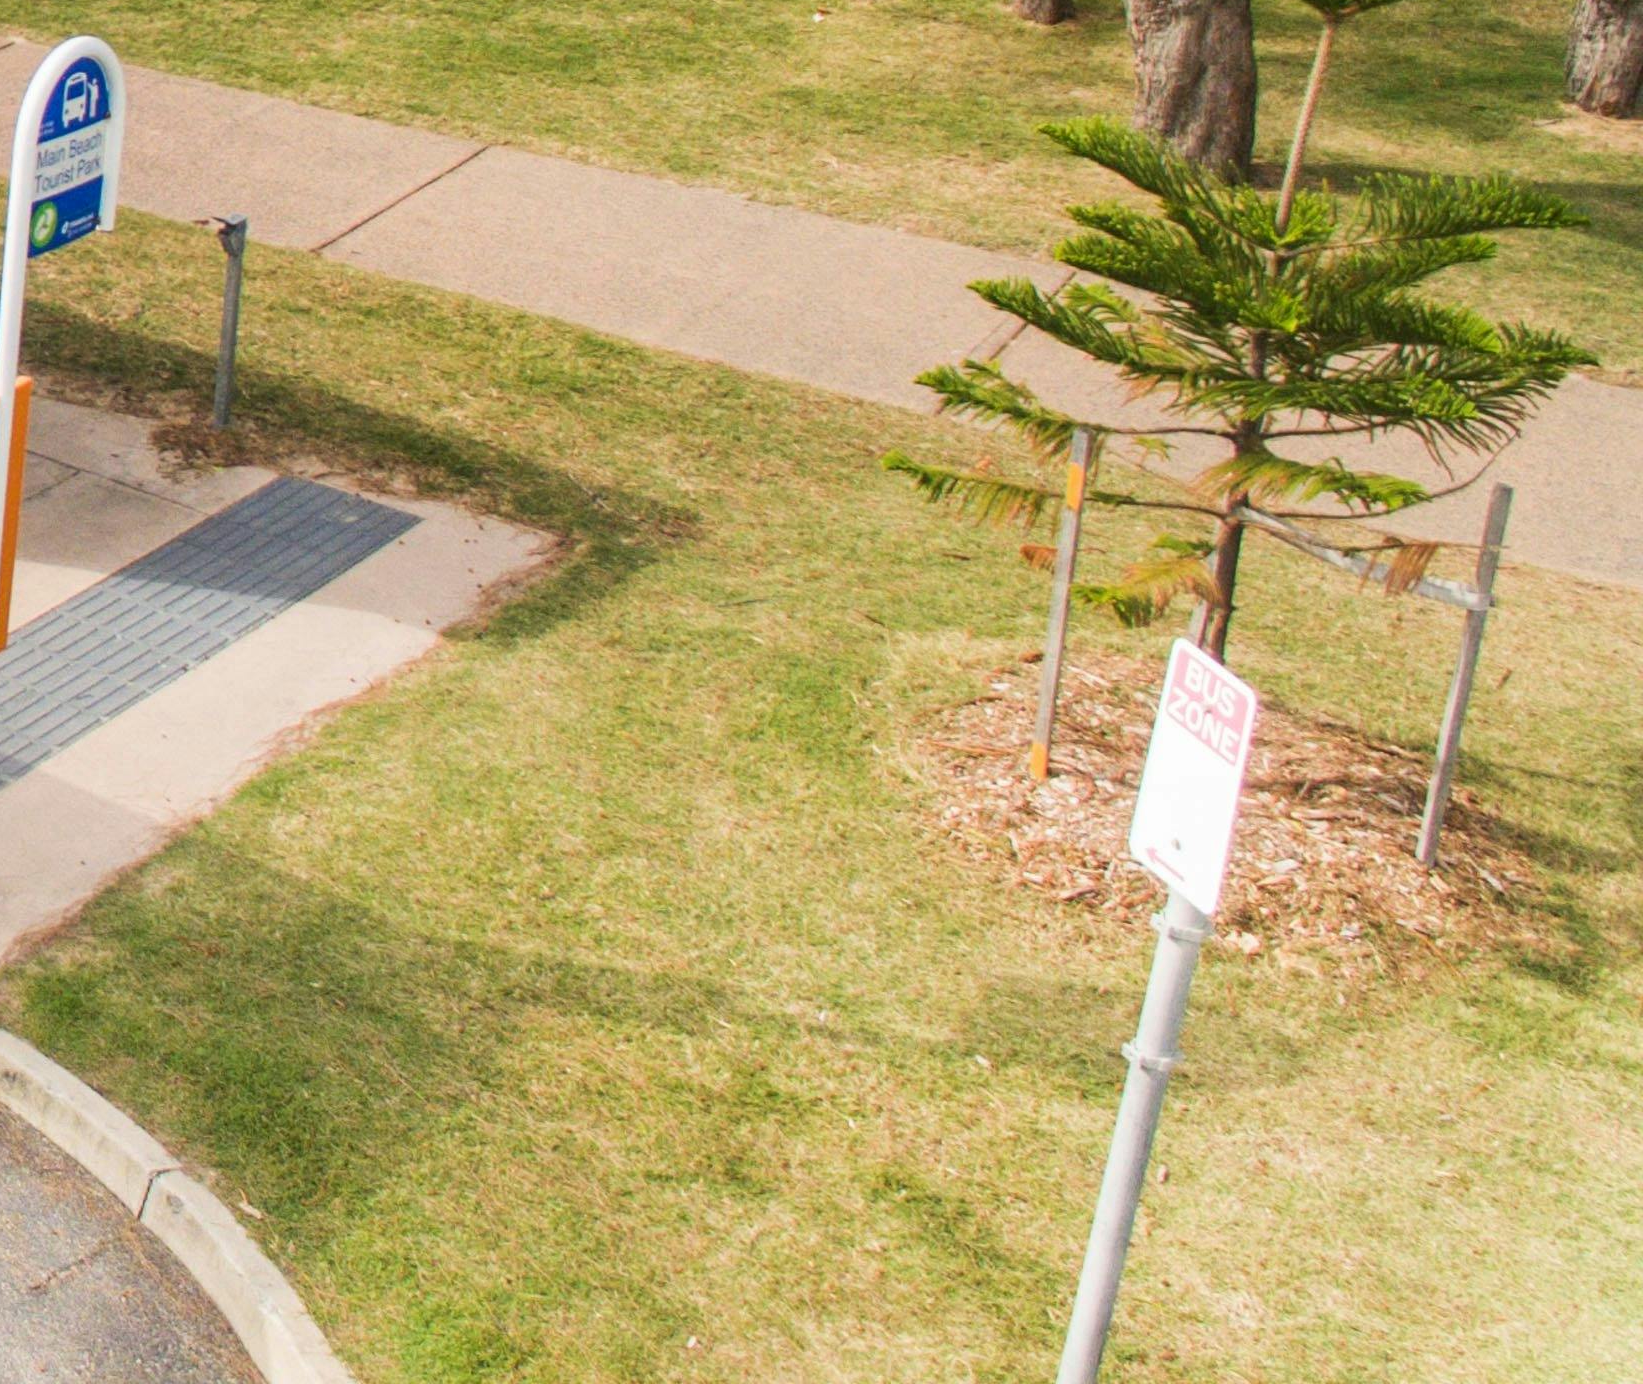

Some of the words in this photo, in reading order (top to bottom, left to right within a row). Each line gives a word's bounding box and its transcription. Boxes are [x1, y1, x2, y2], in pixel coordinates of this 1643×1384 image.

[35, 162, 74, 194] Tourist
[77, 156, 100, 179] Park
[36, 146, 65, 170] Main
[69, 131, 102, 159] Beach
[1183, 658, 1237, 718] BUS
[1166, 686, 1240, 763] ZONE
